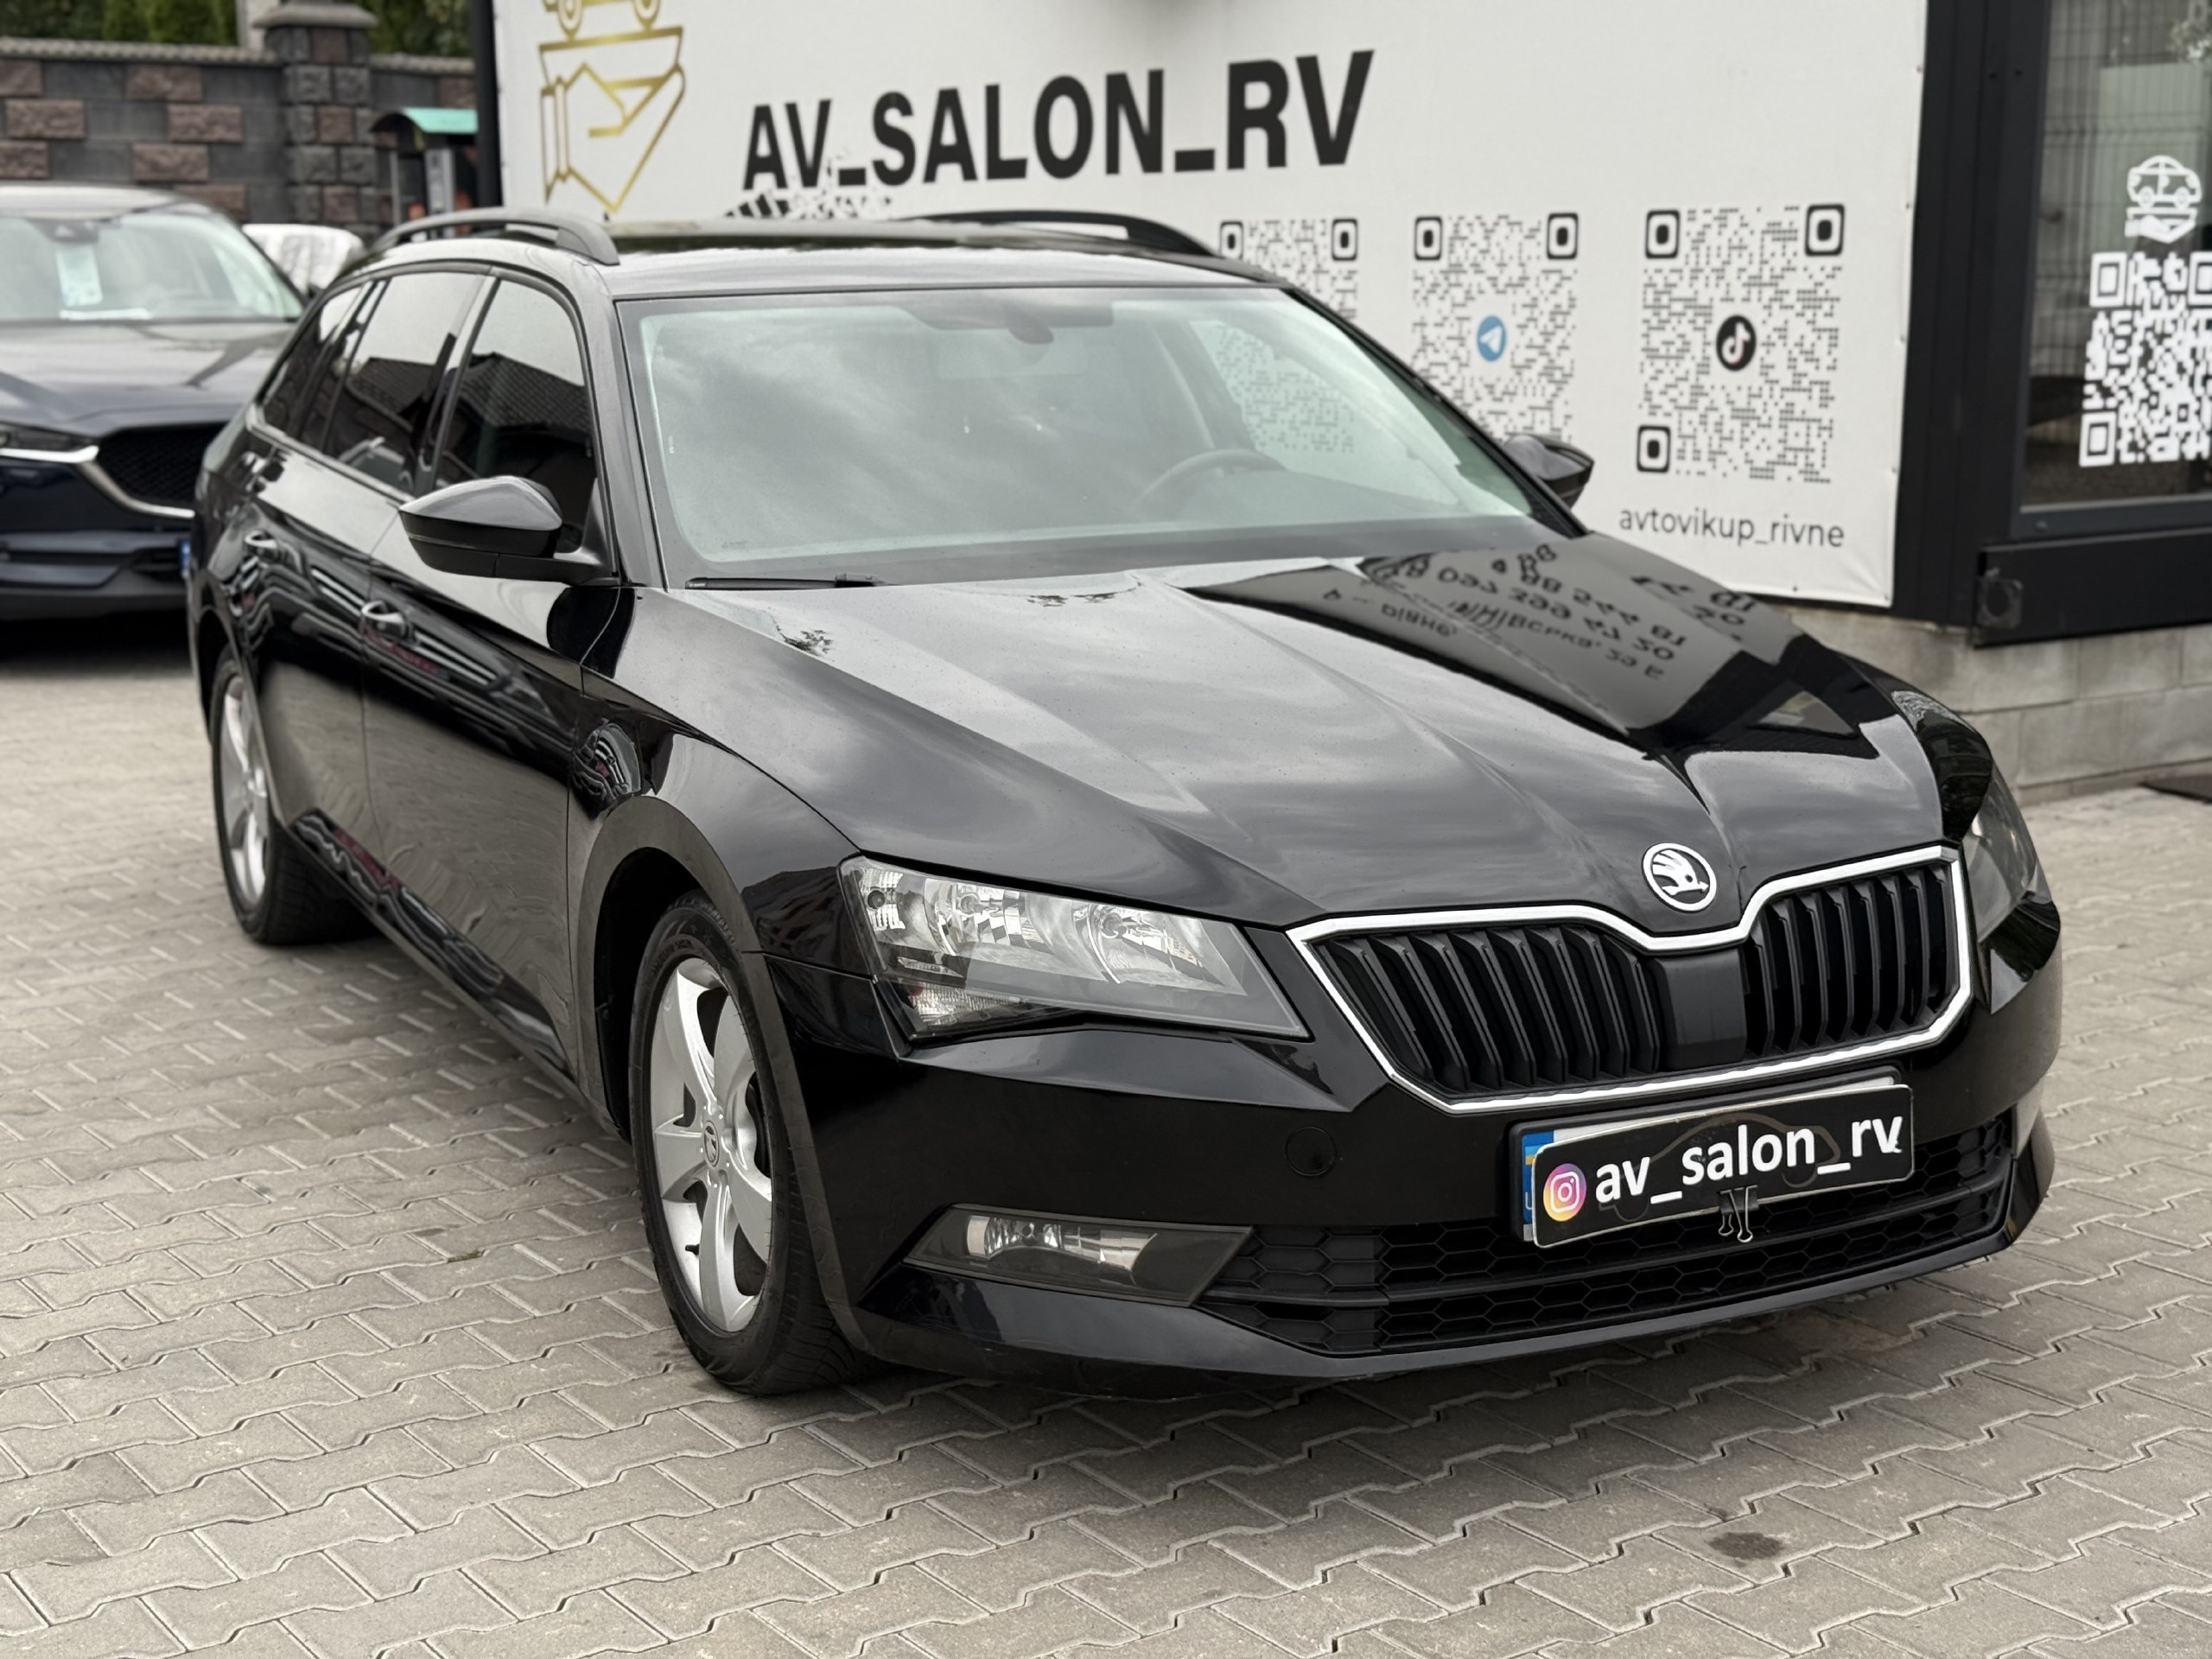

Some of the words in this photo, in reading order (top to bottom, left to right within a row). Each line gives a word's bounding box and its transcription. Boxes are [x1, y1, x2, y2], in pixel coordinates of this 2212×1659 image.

[743, 49, 1375, 191] AV_SALON_RV
[1618, 506, 1845, 548] avtovikup_rivne
[1595, 1116, 1903, 1205] av_salon_rv
